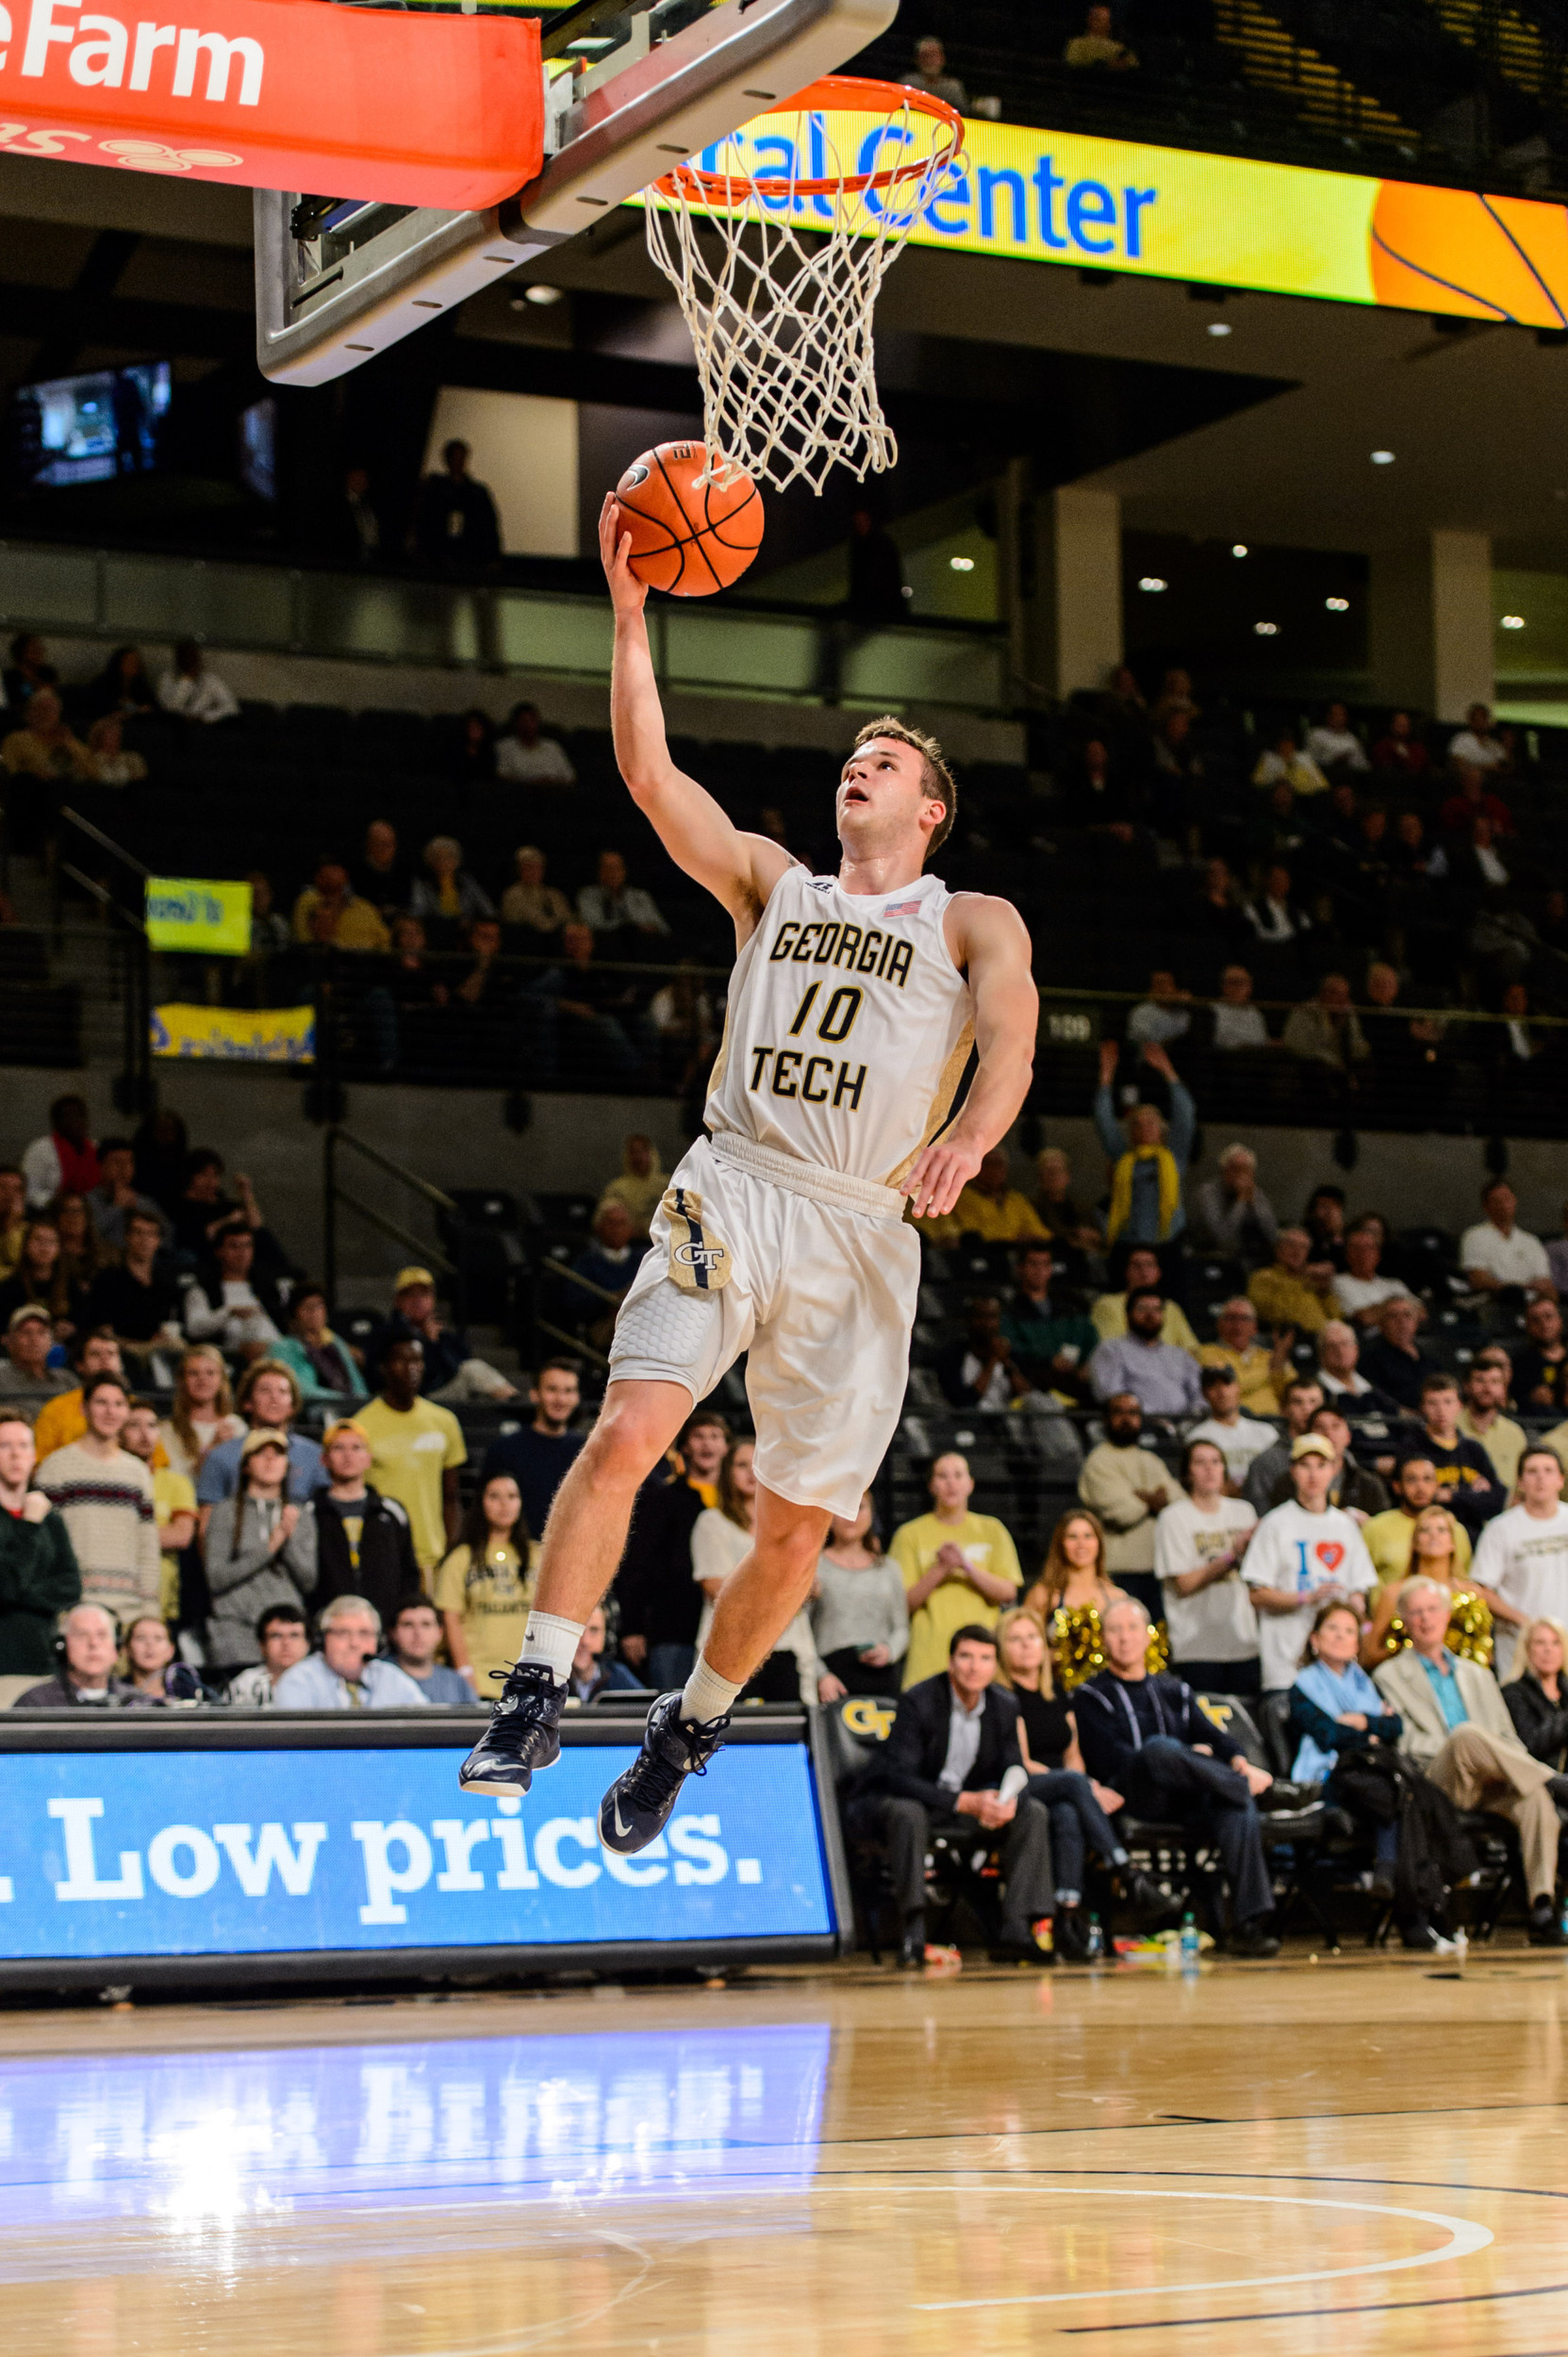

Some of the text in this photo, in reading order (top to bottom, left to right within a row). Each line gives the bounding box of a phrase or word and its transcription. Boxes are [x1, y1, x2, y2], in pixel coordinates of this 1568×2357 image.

[0, 0, 265, 107] Farm
[857, 124, 1157, 257] Center
[768, 920, 916, 990] GEORGIA
[787, 980, 865, 1045] 10
[749, 1045, 868, 1113] TECH
[674, 1241, 724, 1270] GT
[841, 1699, 897, 1741] GT
[47, 1798, 328, 1903] Low
